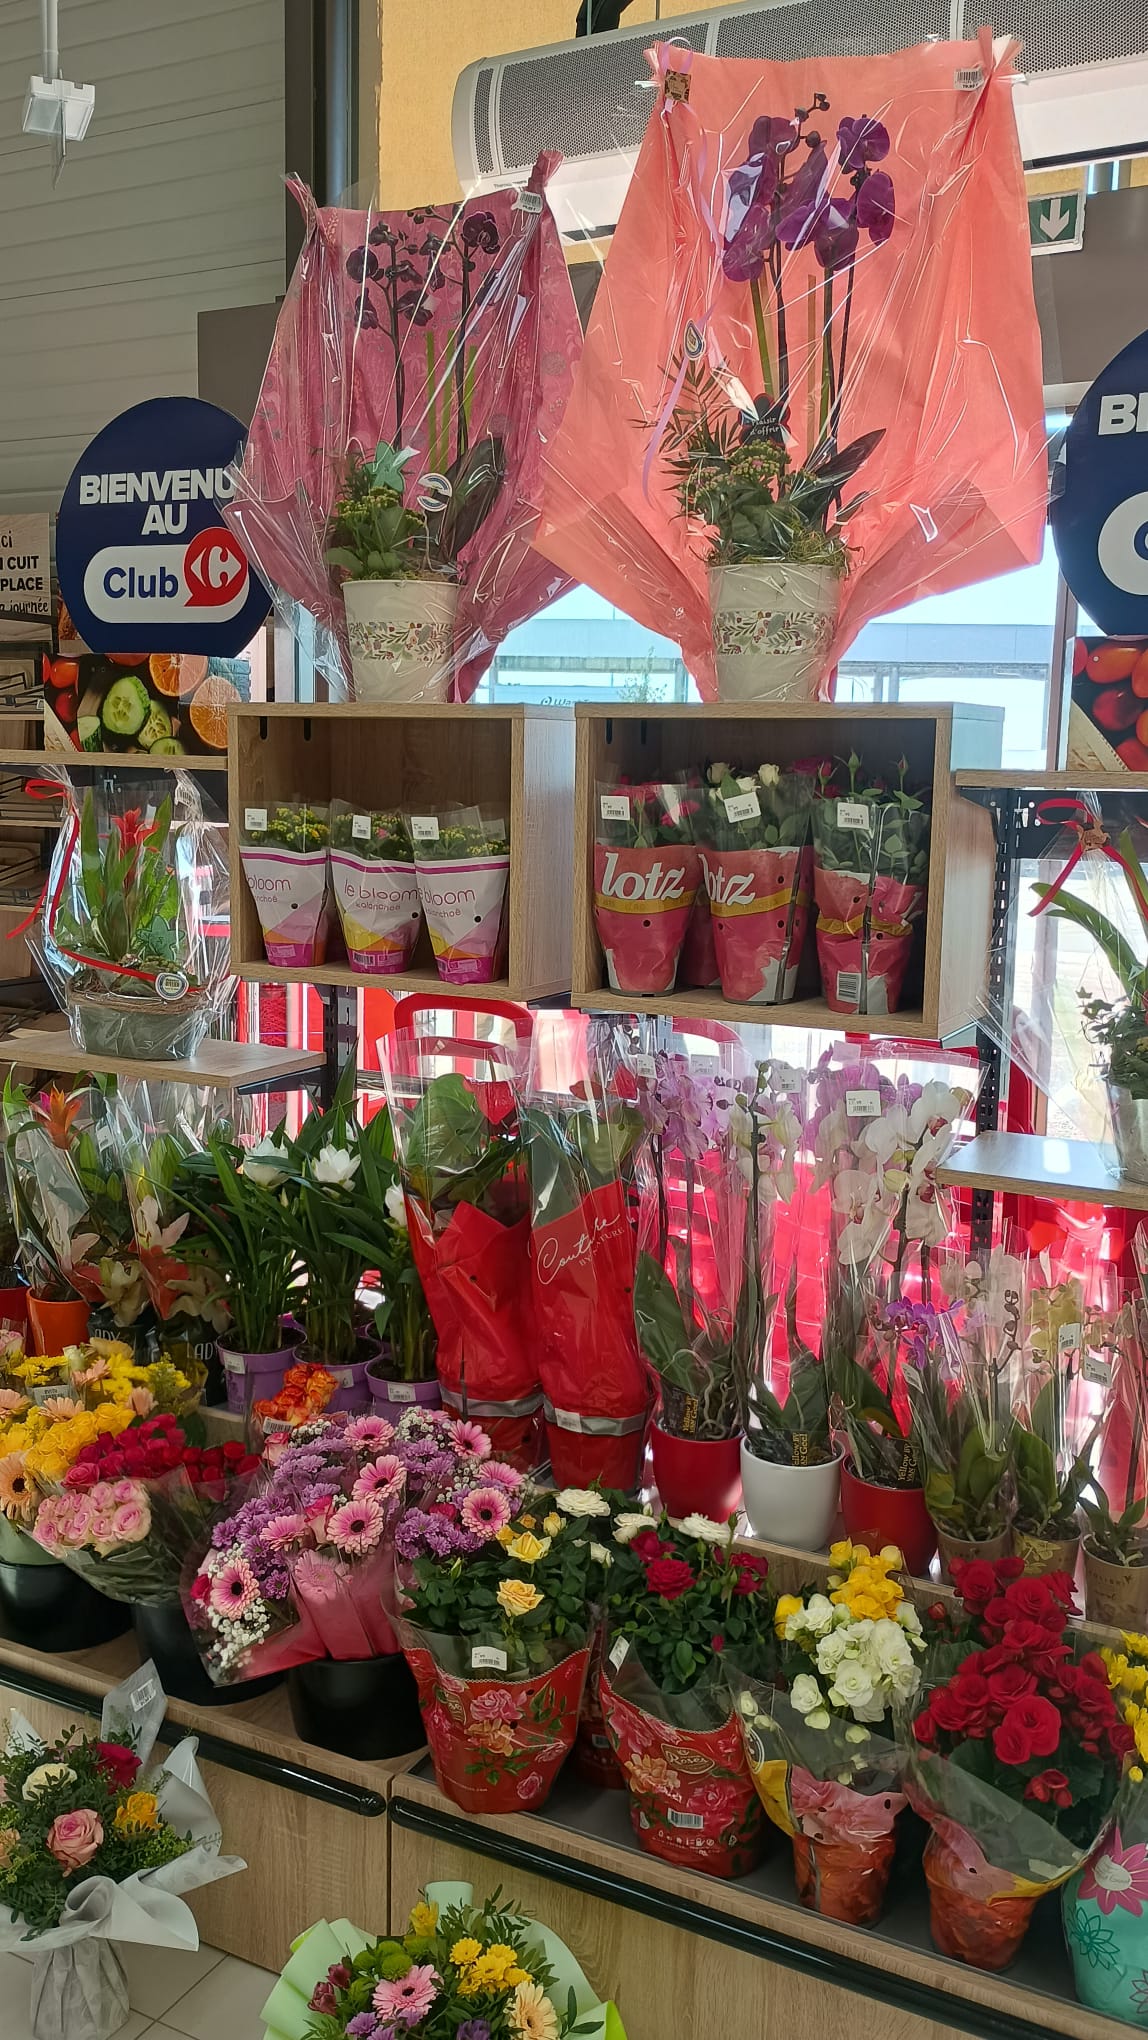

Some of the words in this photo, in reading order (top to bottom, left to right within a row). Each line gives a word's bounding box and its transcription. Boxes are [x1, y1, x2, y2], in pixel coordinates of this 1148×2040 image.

[80, 469, 234, 505] BIENVENU
[141, 504, 188, 535] AU
[0, 531, 12, 548] ci
[7, 555, 39, 570] CUIT
[0, 577, 43, 592] PLACE
[103, 566, 179, 599] Club
[602, 852, 686, 900] lotz
[344, 878, 355, 897] le
[359, 886, 418, 902] bloom
[791, 1442, 800, 1466] ellow
